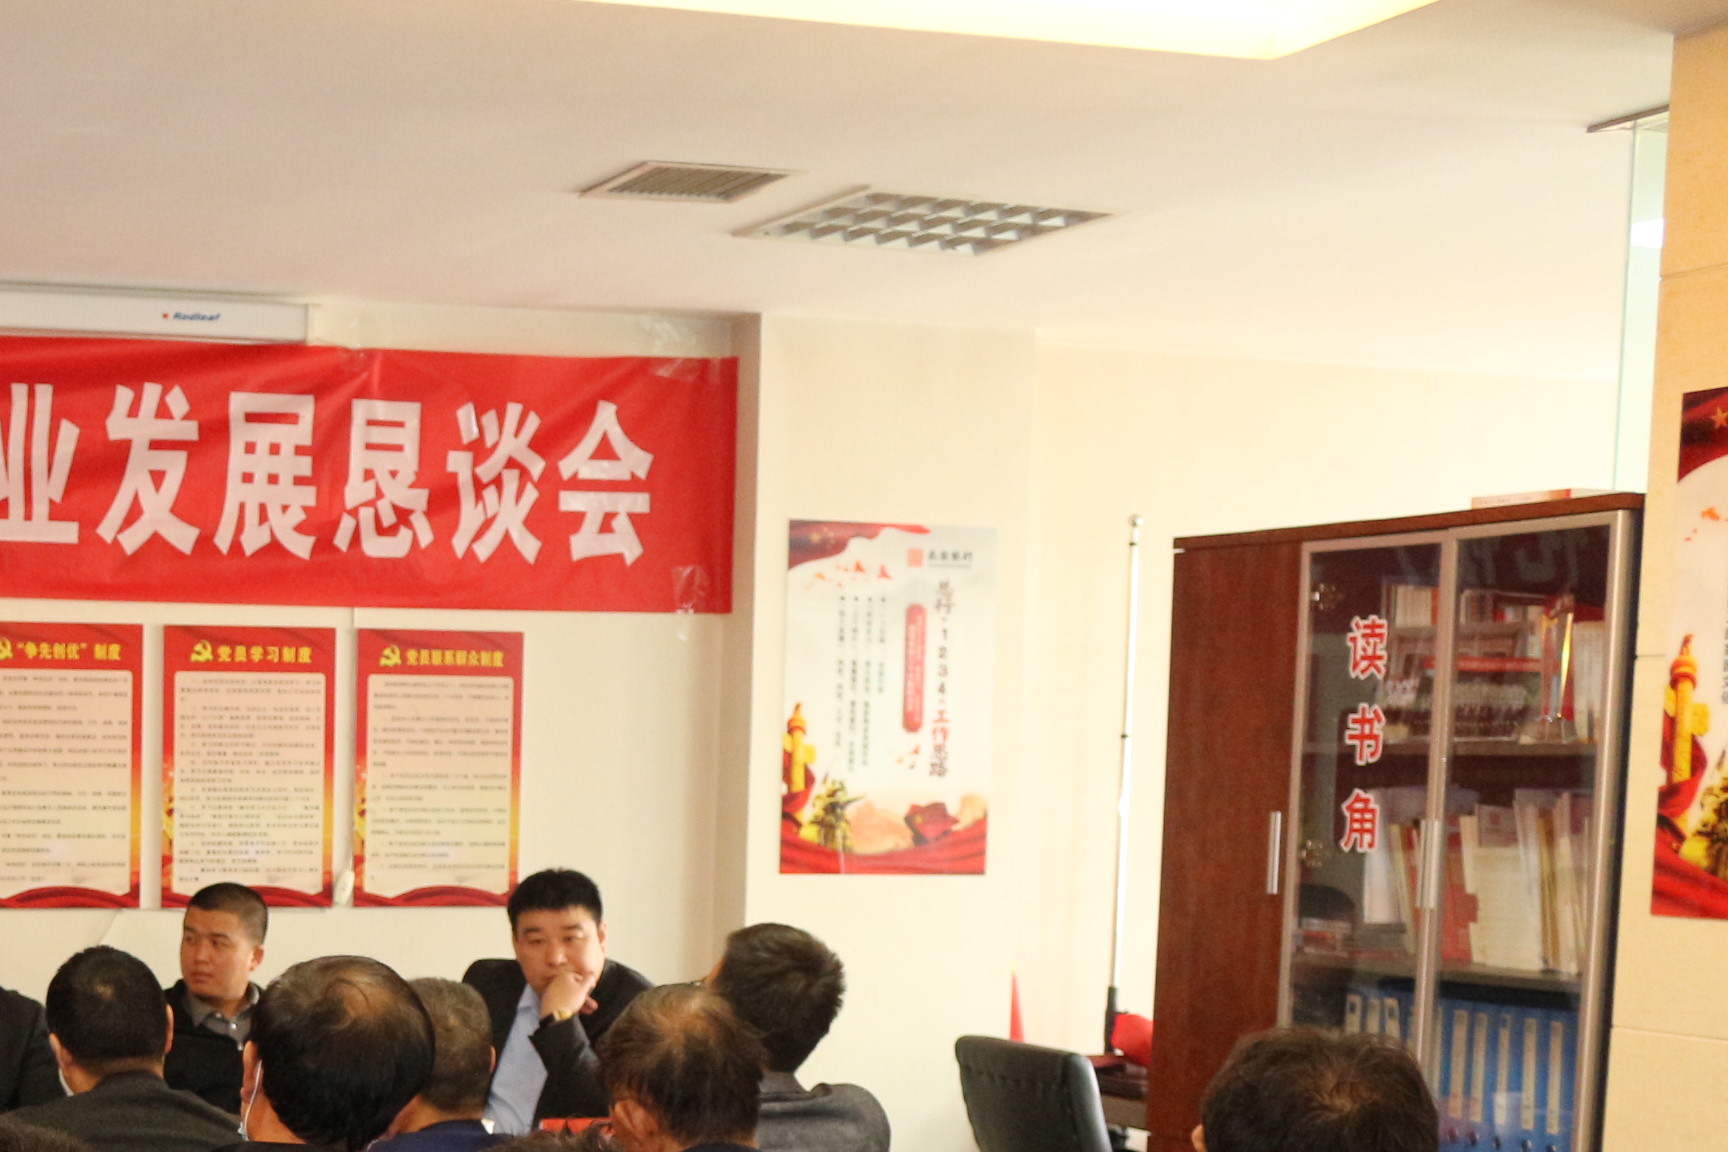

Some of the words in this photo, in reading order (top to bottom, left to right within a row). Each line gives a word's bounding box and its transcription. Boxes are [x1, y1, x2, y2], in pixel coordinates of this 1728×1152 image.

[218, 645, 312, 663] 党员学习制度
[406, 648, 504, 667] 党员联系群众制度
[1342, 616, 1388, 852] 读书角
